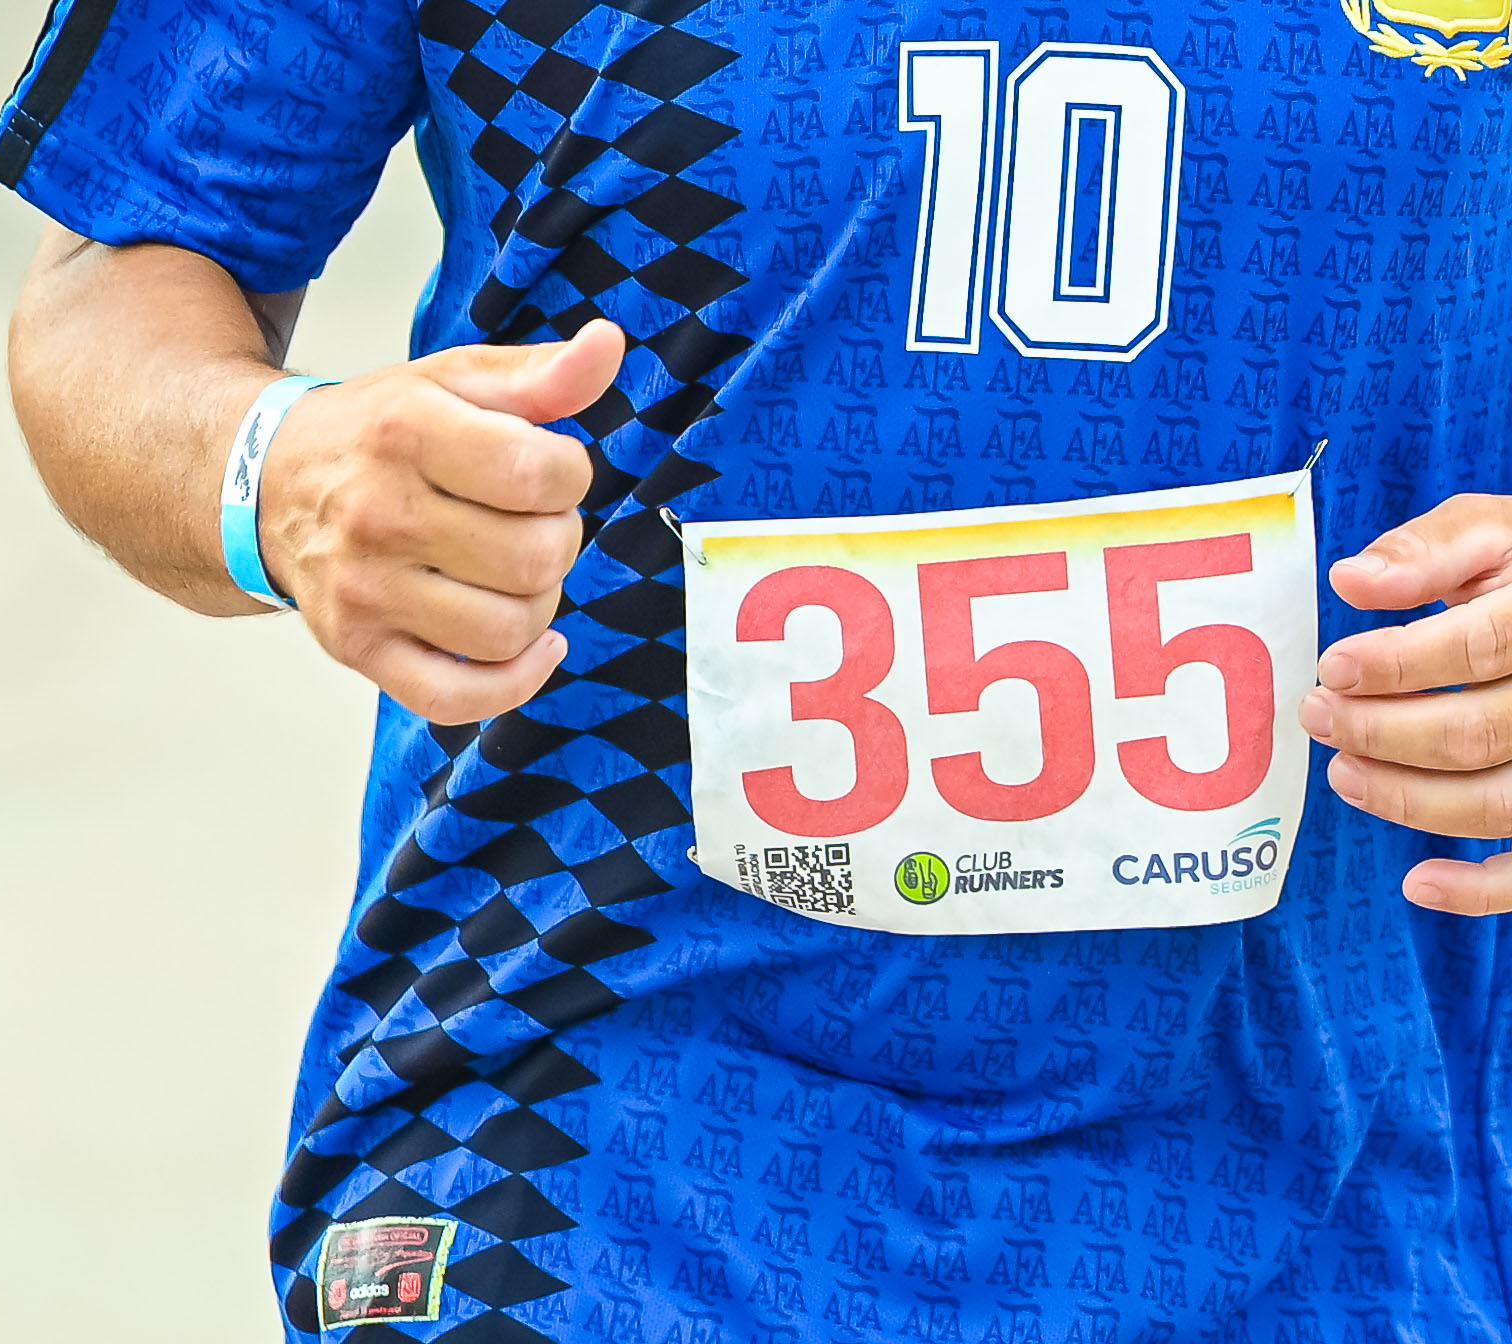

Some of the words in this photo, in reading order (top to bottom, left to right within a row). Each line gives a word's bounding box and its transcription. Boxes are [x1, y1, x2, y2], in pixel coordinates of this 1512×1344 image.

[1174, 15, 1243, 79] AFA
[1258, 22, 1327, 86] AFA
[757, 89, 826, 152] AFA
[1254, 90, 1323, 154] AFA
[1338, 95, 1398, 159] AFA
[1409, 100, 1463, 166] AFA
[763, 156, 831, 219] AFA
[899, 41, 1186, 362] 10
[1247, 157, 1316, 221] AFA
[1327, 160, 1388, 227] AFA
[815, 402, 884, 466] AFA
[897, 405, 966, 469] AFA
[979, 408, 1048, 472] AFA
[1061, 412, 1130, 476] AFA
[1142, 414, 1202, 478] AFA
[735, 533, 1275, 837] 355
[954, 869, 1064, 894] RUNNER'S
[956, 851, 1012, 873] CLUB
[1112, 840, 1278, 885] CARUSO
[1210, 870, 1278, 895] SEGUROS
[695, 1061, 755, 1119] AFA
[606, 1108, 666, 1166] AFA
[682, 1124, 742, 1182] AFA
[760, 1139, 820, 1197] AFA
[600, 1167, 660, 1235] AFA
[1207, 1142, 1267, 1200] AFA
[750, 1203, 810, 1261] AFA
[829, 1213, 889, 1281] AFA
[1139, 1191, 1192, 1250] AFA
[350, 1284, 389, 1300] adidas
[989, 1239, 1049, 1293] AFA
[1069, 1243, 1129, 1297] AFA
